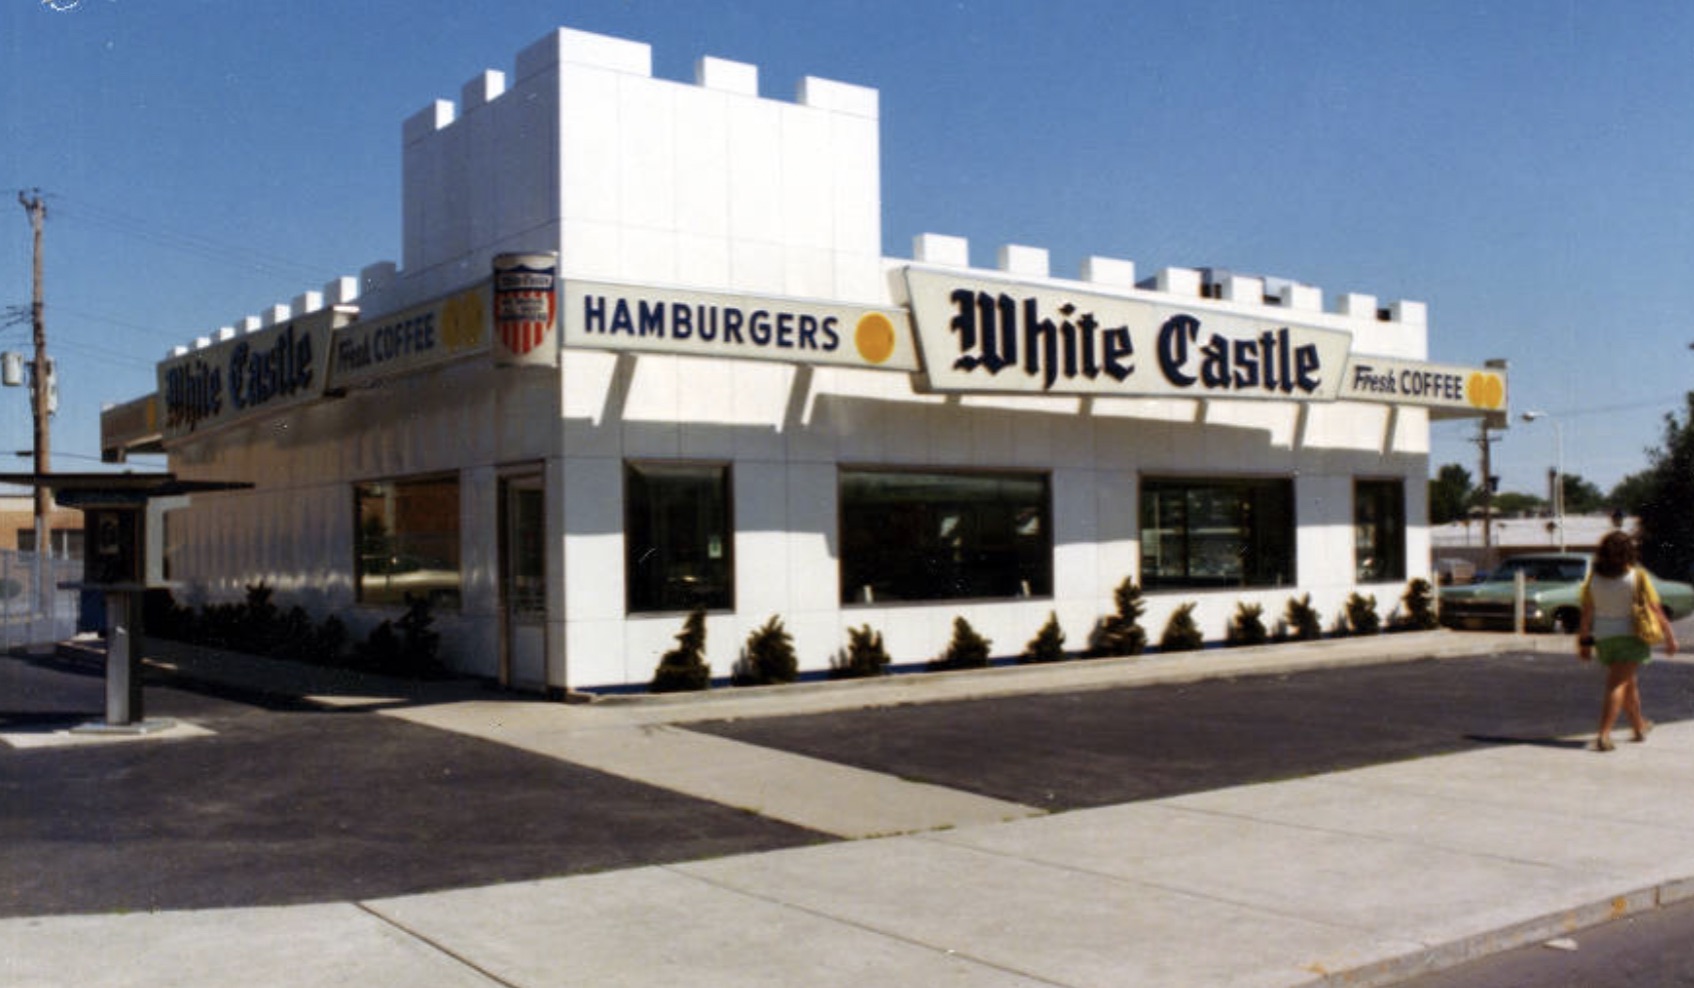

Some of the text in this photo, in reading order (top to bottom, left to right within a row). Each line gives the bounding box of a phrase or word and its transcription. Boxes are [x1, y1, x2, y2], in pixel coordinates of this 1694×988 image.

[373, 311, 436, 363] COFFEE
[584, 294, 840, 352] HAMBURGERS
[950, 289, 1321, 394] White Castle
[165, 321, 313, 432] White Castle
[1353, 364, 1463, 400] Fresh COFFEE
